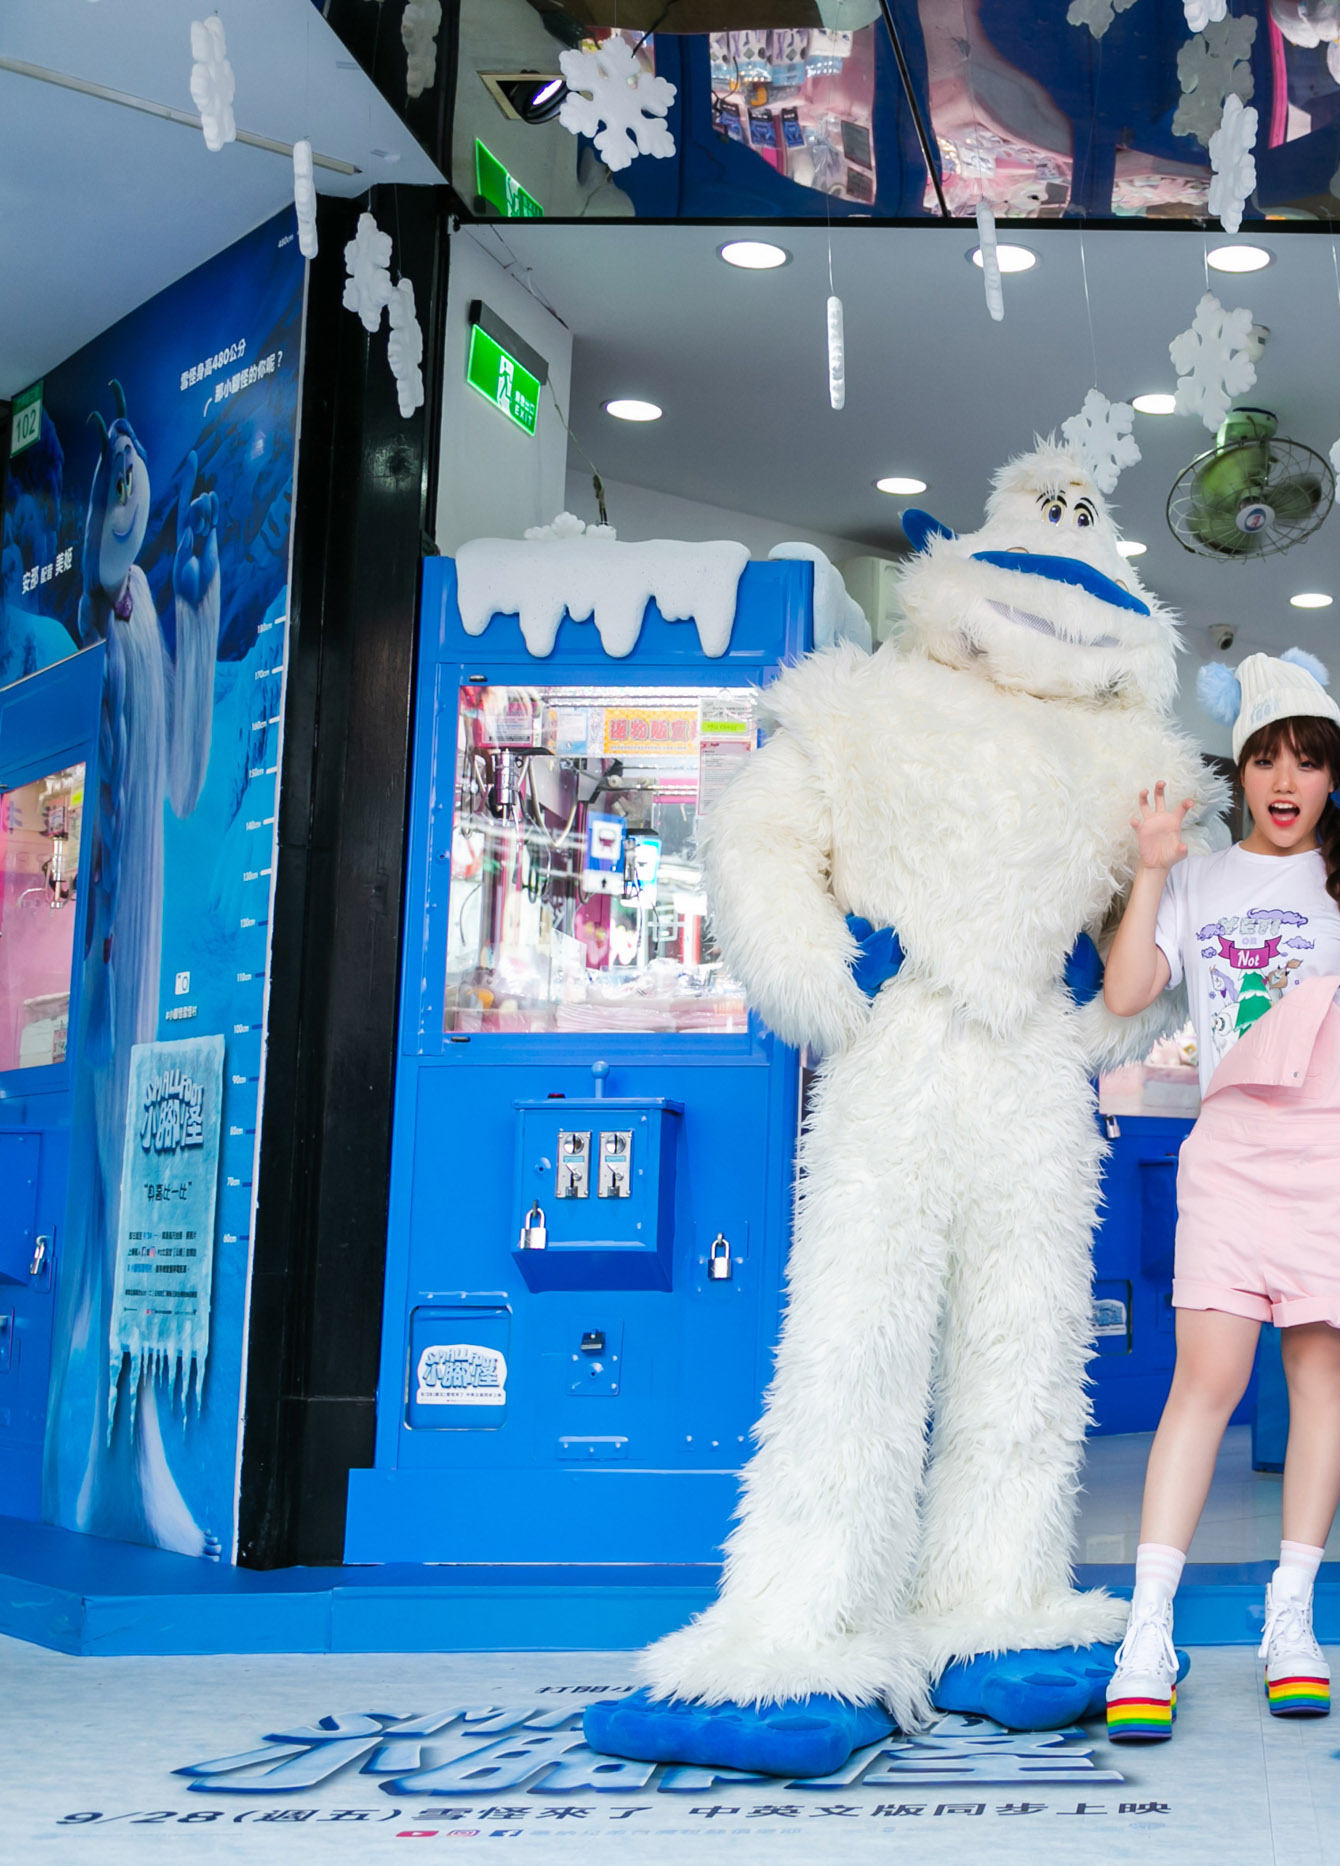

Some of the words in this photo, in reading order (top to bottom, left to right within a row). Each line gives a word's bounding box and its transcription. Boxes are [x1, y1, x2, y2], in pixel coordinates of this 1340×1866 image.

[15, 409, 36, 444] 102
[514, 403, 534, 427] EXIT
[254, 668, 270, 681] 170cm
[610, 718, 698, 742] 選物販賣
[1218, 915, 1284, 936] YETI
[1241, 936, 1258, 945] OR
[1236, 949, 1261, 968] Not
[143, 1068, 205, 1112] SMALLFOOT
[139, 1098, 204, 1155] 小腳怪
[54, 1806, 650, 1827] 9/28(週五)雪怪來了
[686, 1799, 1173, 1820] 中英文版同步上映
